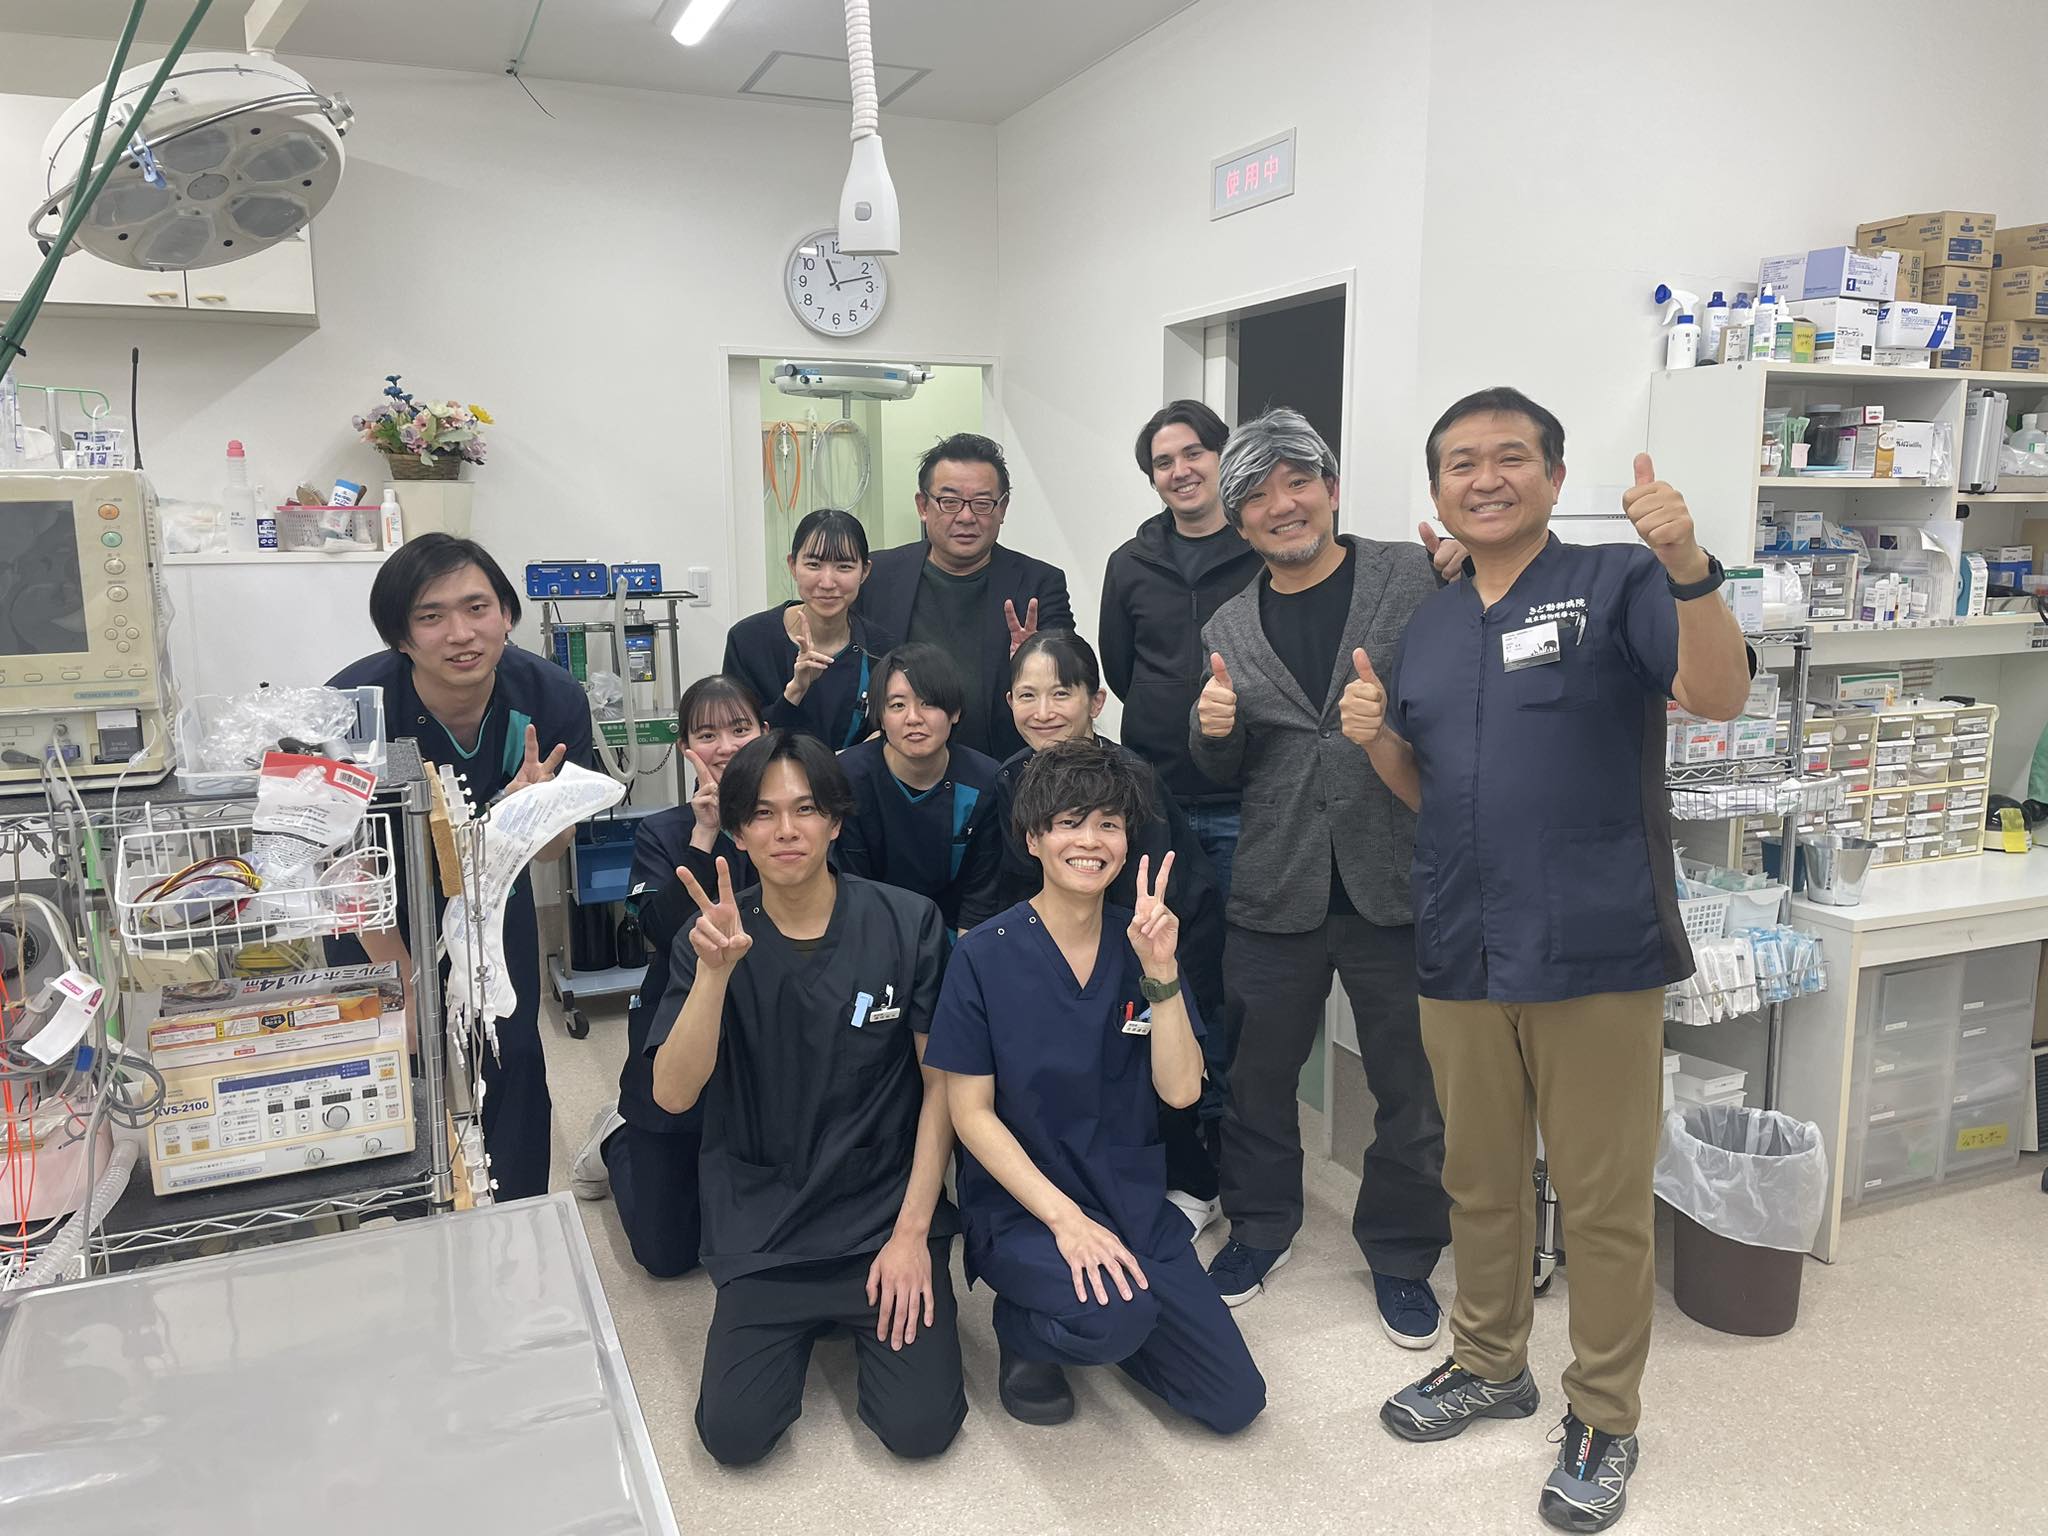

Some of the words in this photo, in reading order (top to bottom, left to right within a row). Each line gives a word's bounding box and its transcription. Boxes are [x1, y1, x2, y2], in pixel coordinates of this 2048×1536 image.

[1226, 155, 1279, 199] 使用中
[816, 245, 825, 257] 11
[803, 258, 815, 270] 10
[861, 262, 869, 275] 2
[799, 275, 807, 287] 9
[865, 281, 874, 293] 3
[804, 294, 813, 306] 8
[860, 299, 868, 310] 4
[817, 307, 825, 319] 7
[832, 313, 840, 325] 6
[849, 310, 857, 322] 5
